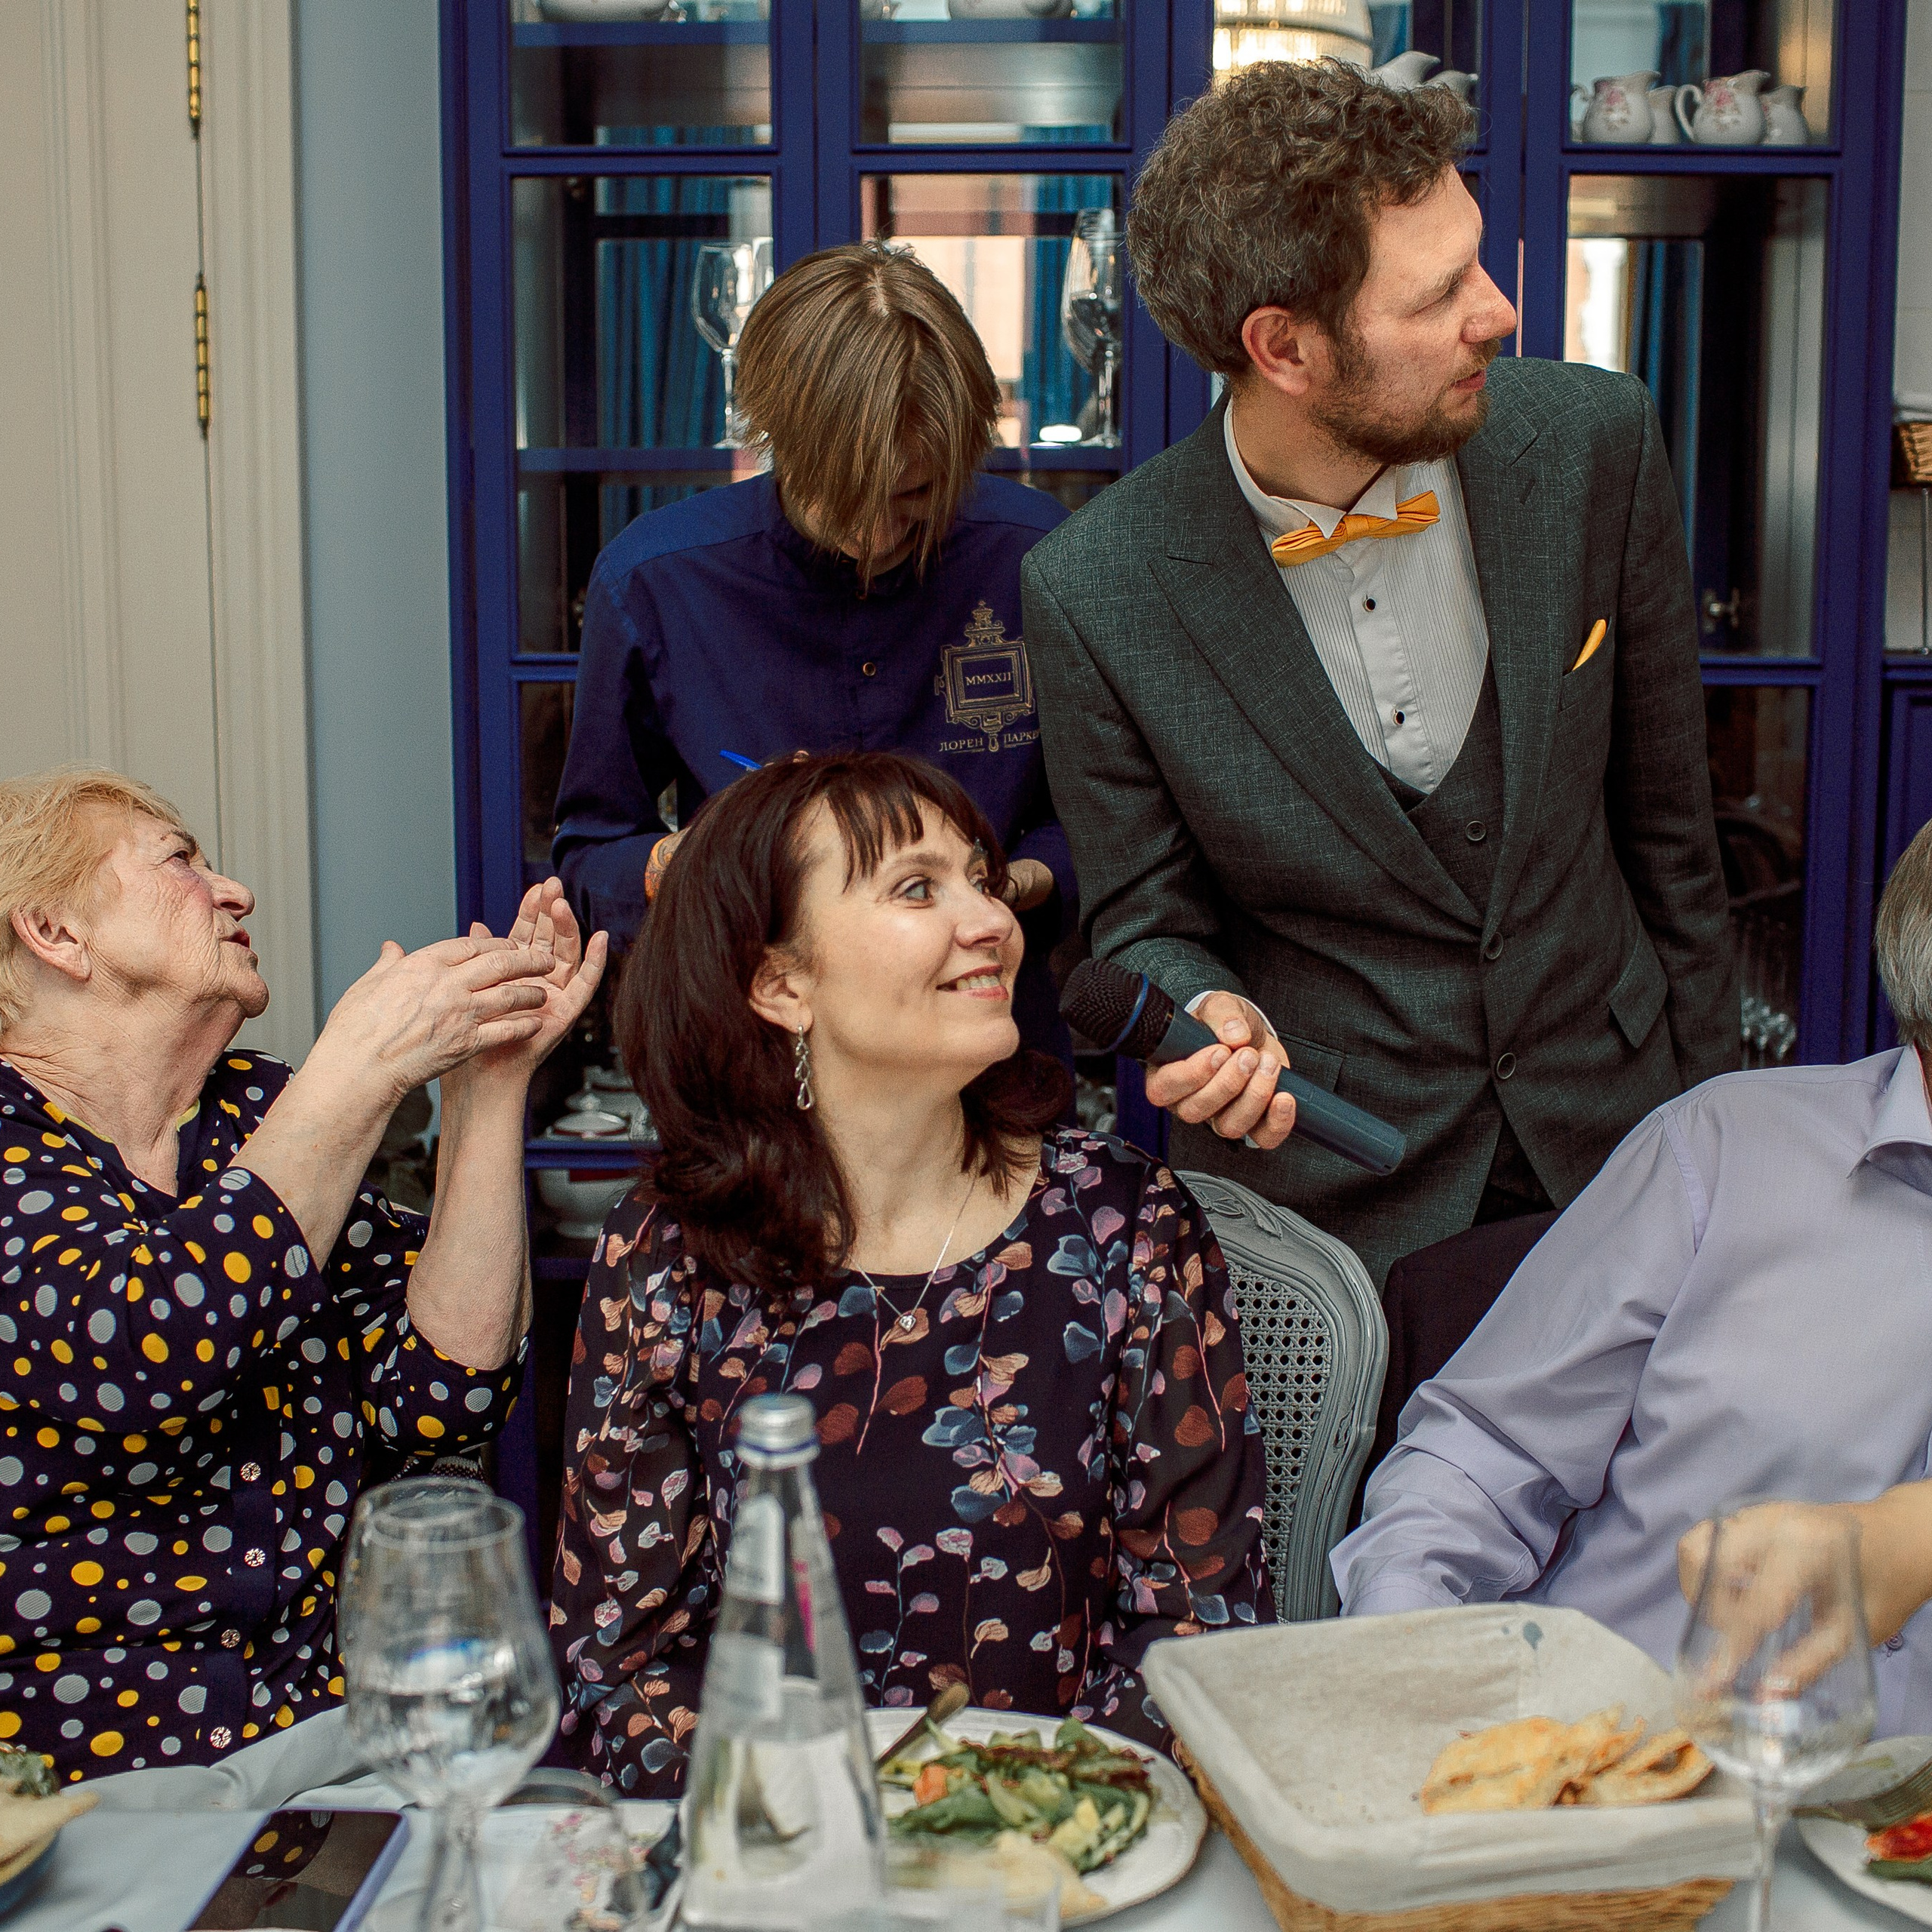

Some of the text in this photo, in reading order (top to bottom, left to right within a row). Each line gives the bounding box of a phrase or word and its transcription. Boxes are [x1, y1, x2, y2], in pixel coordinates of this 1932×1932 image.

[964, 672, 1011, 686] MMXXII
[939, 729, 1041, 752] ЛОРЕН ПАРКЕ
